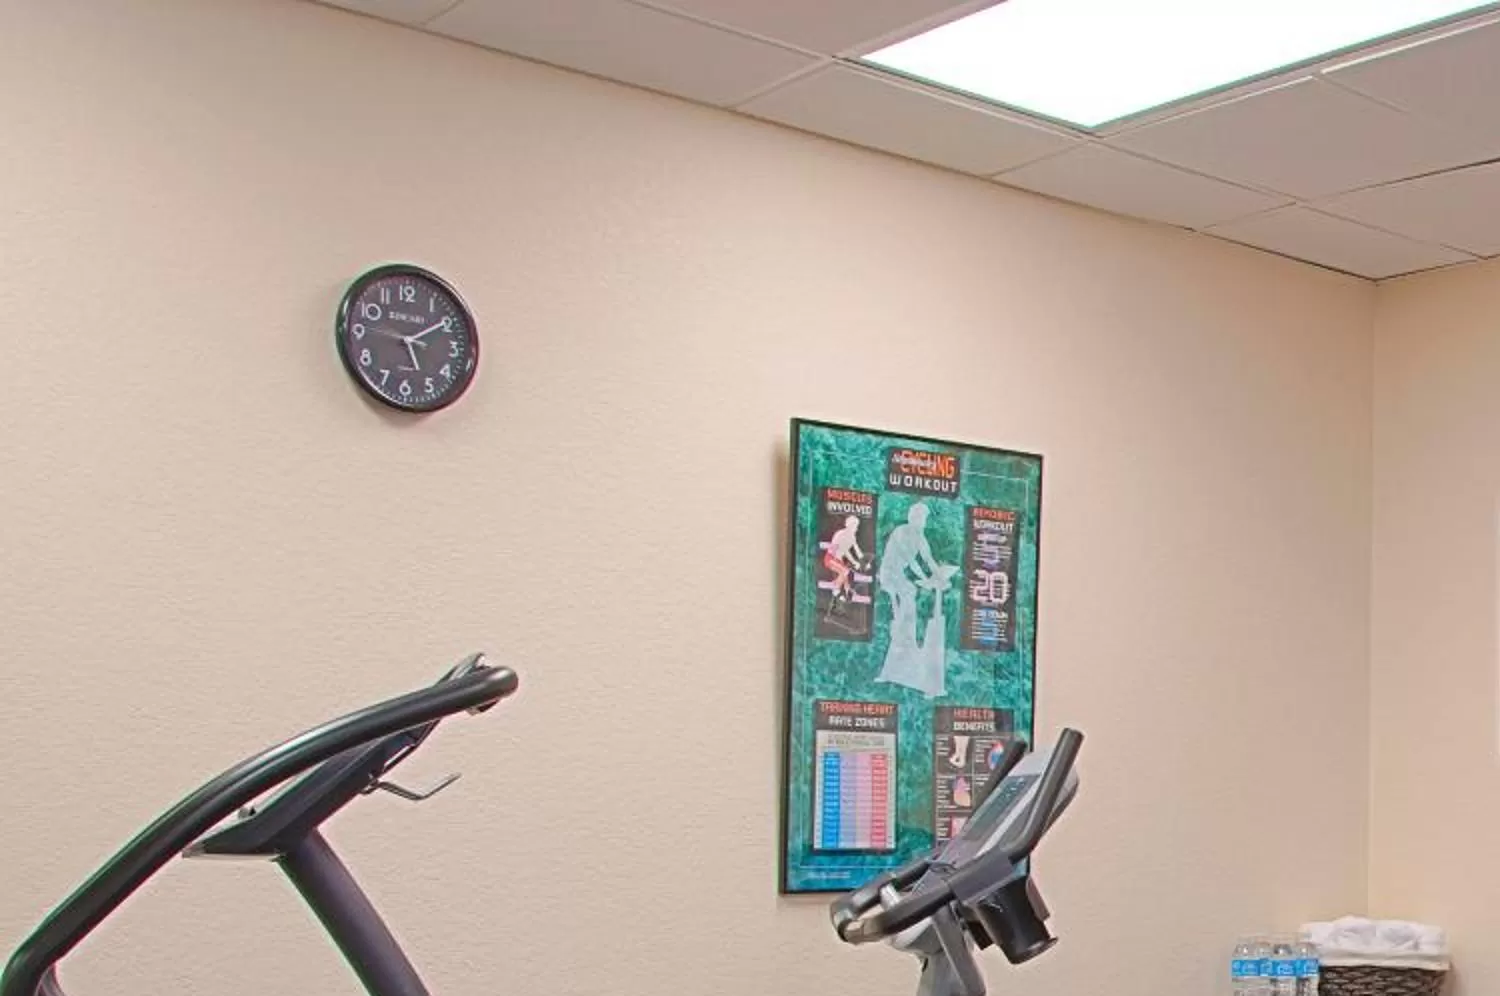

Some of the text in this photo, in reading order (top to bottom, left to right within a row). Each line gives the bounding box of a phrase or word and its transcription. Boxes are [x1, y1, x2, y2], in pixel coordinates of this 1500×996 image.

[381, 287, 391, 305] 11
[400, 285, 416, 303] 12
[361, 302, 382, 321] 10
[429, 297, 435, 313] 1
[352, 323, 365, 340] 9
[442, 315, 453, 333] 2
[360, 348, 372, 366] 8
[448, 340, 460, 358] 3
[380, 369, 391, 386] 7
[440, 363, 451, 379] 4
[399, 379, 412, 396] 6
[424, 377, 435, 393] 5
[889, 472, 958, 493] WORKOUT
[972, 569, 1008, 604] 20
